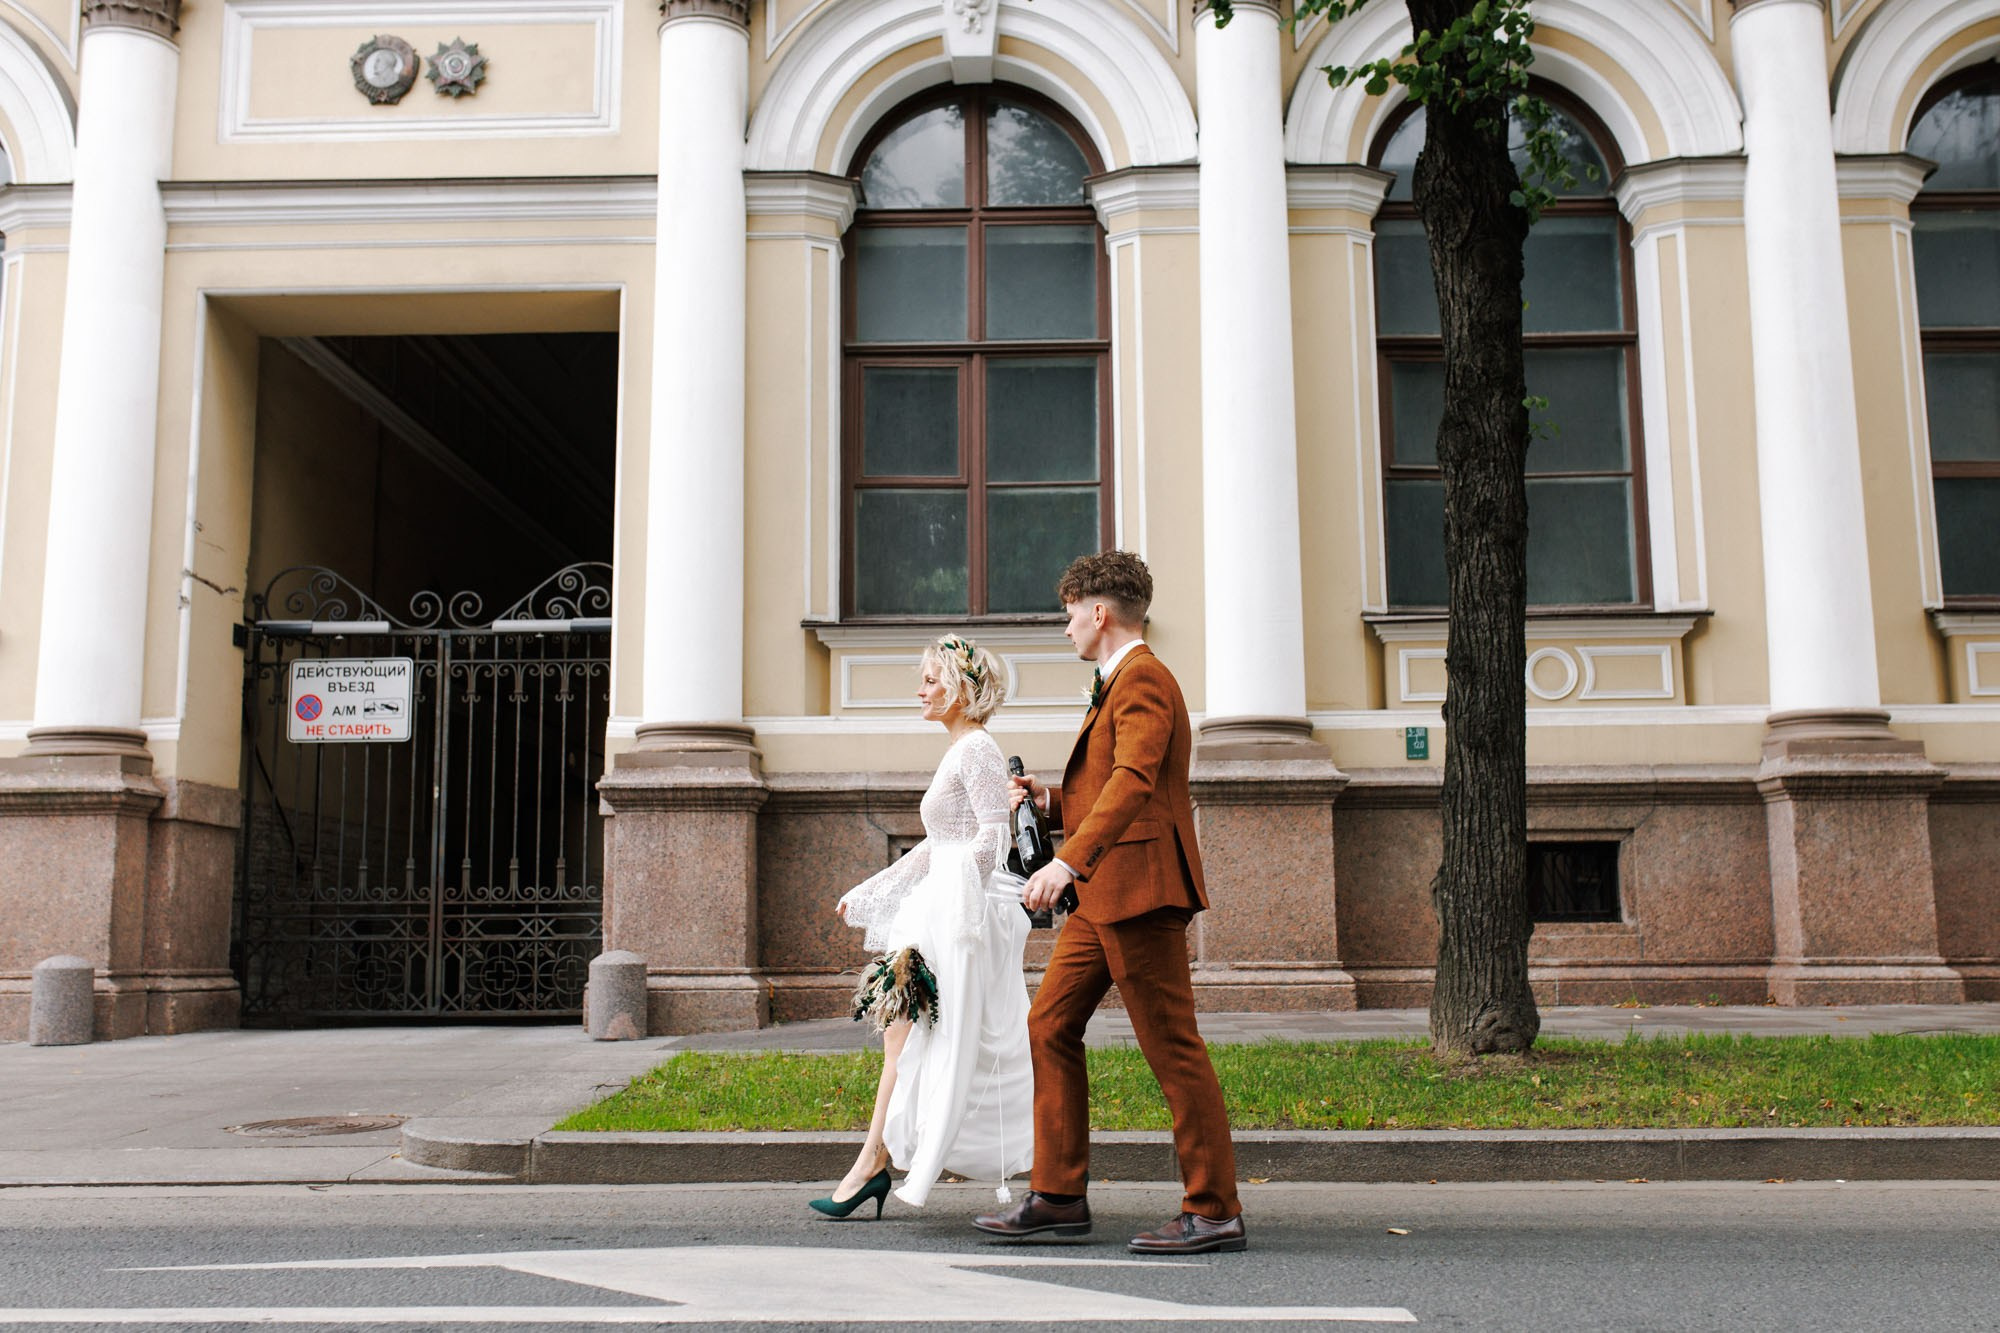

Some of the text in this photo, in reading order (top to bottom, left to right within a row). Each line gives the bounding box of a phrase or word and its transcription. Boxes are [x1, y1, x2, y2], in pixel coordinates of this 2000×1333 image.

[296, 664, 406, 679] ДЕЙСТВУЮЩИЙ
[328, 682, 375, 693] ВЪЕЗД
[332, 705, 356, 716] А/М
[306, 724, 392, 736] НЕ СТАВИТЬ
